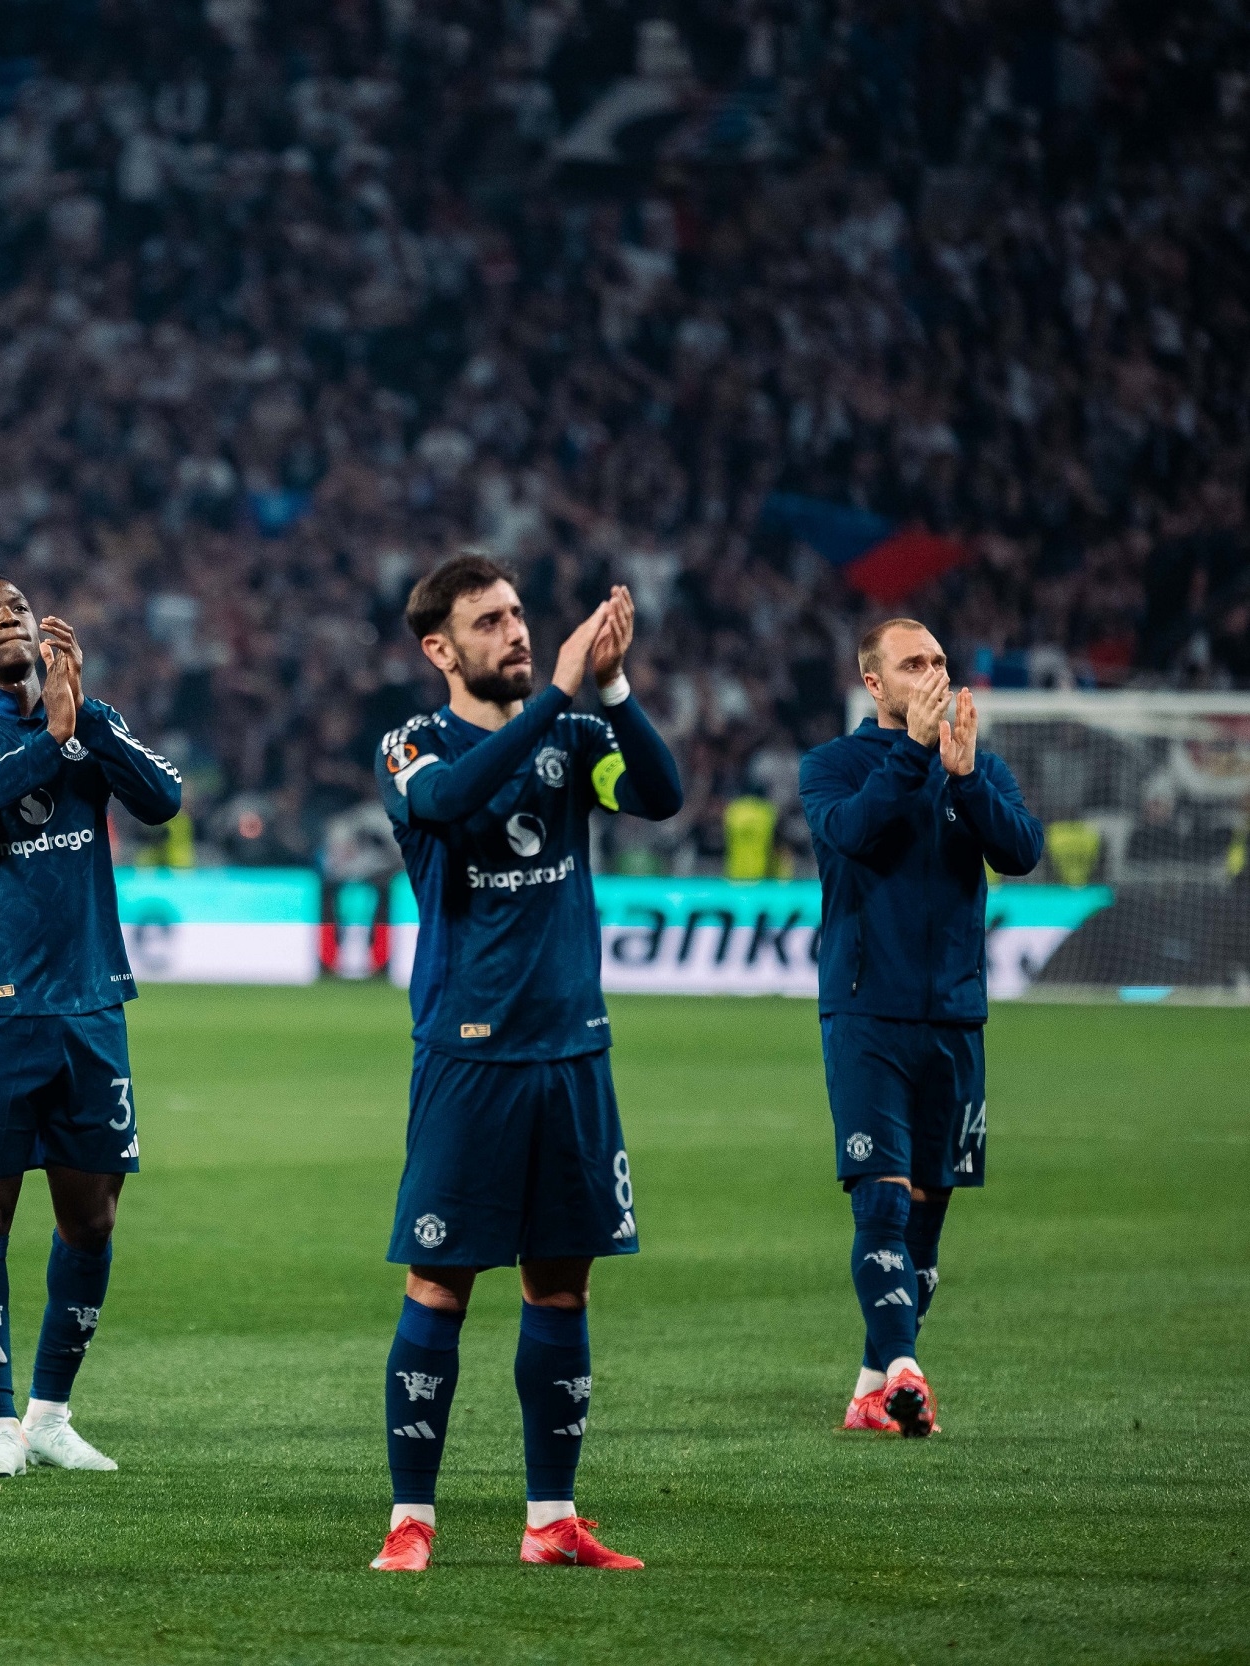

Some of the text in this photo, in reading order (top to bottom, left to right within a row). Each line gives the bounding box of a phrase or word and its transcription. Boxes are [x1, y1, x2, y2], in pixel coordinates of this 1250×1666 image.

[109, 1078, 137, 1131] 3
[958, 1100, 987, 1150] 14
[613, 1150, 633, 1210] 8
